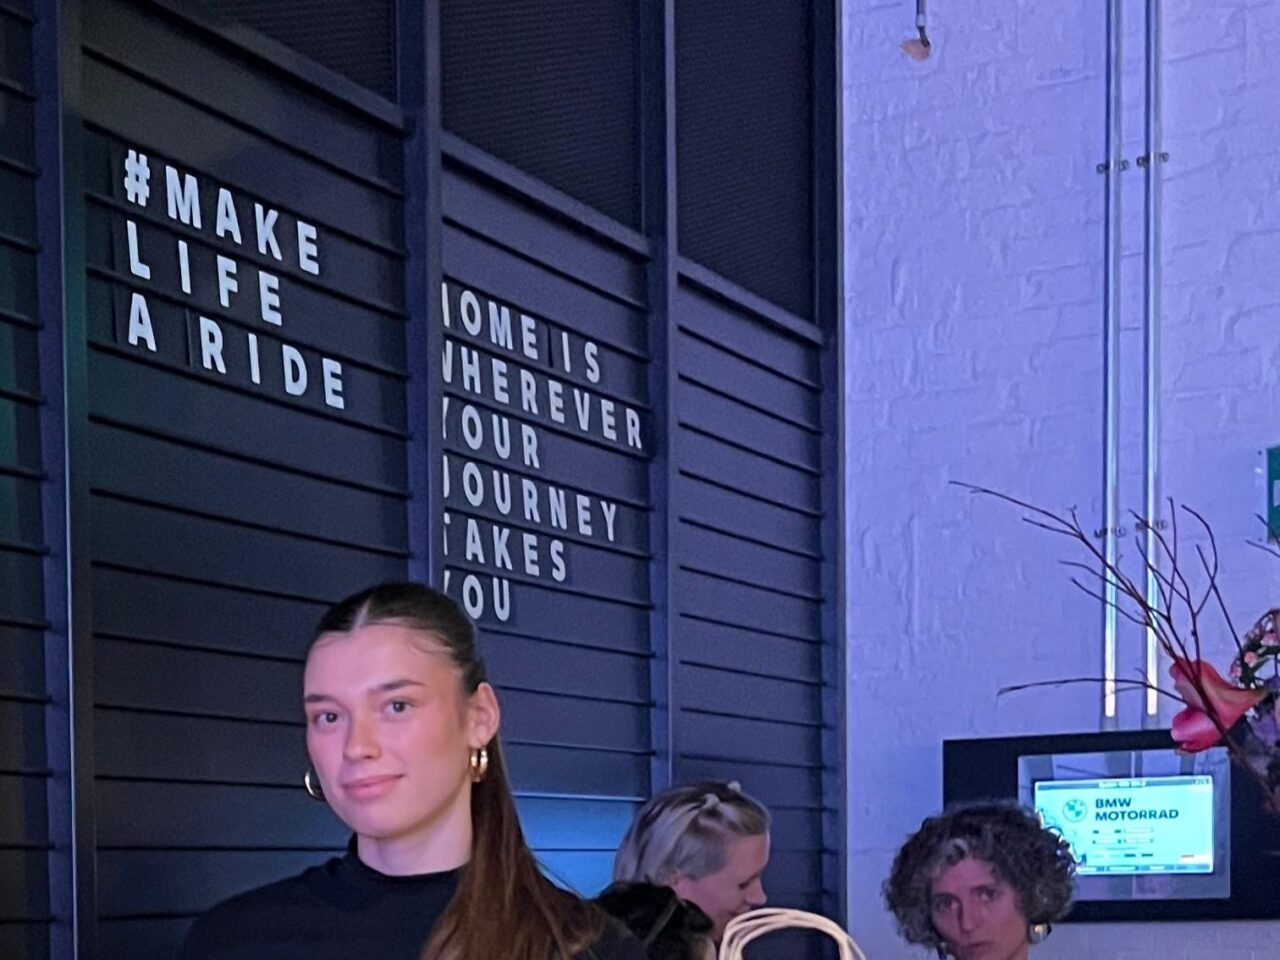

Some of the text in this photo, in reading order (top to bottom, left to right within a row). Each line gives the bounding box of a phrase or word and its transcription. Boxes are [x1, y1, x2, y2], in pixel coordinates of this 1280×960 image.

[124, 149, 320, 275] #MAKE
[127, 221, 282, 326] LIFE
[128, 293, 345, 409] A RIDE
[561, 332, 600, 383] IS
[1095, 798, 1131, 808] BMW
[1095, 809, 1179, 821] MOTORRAD
